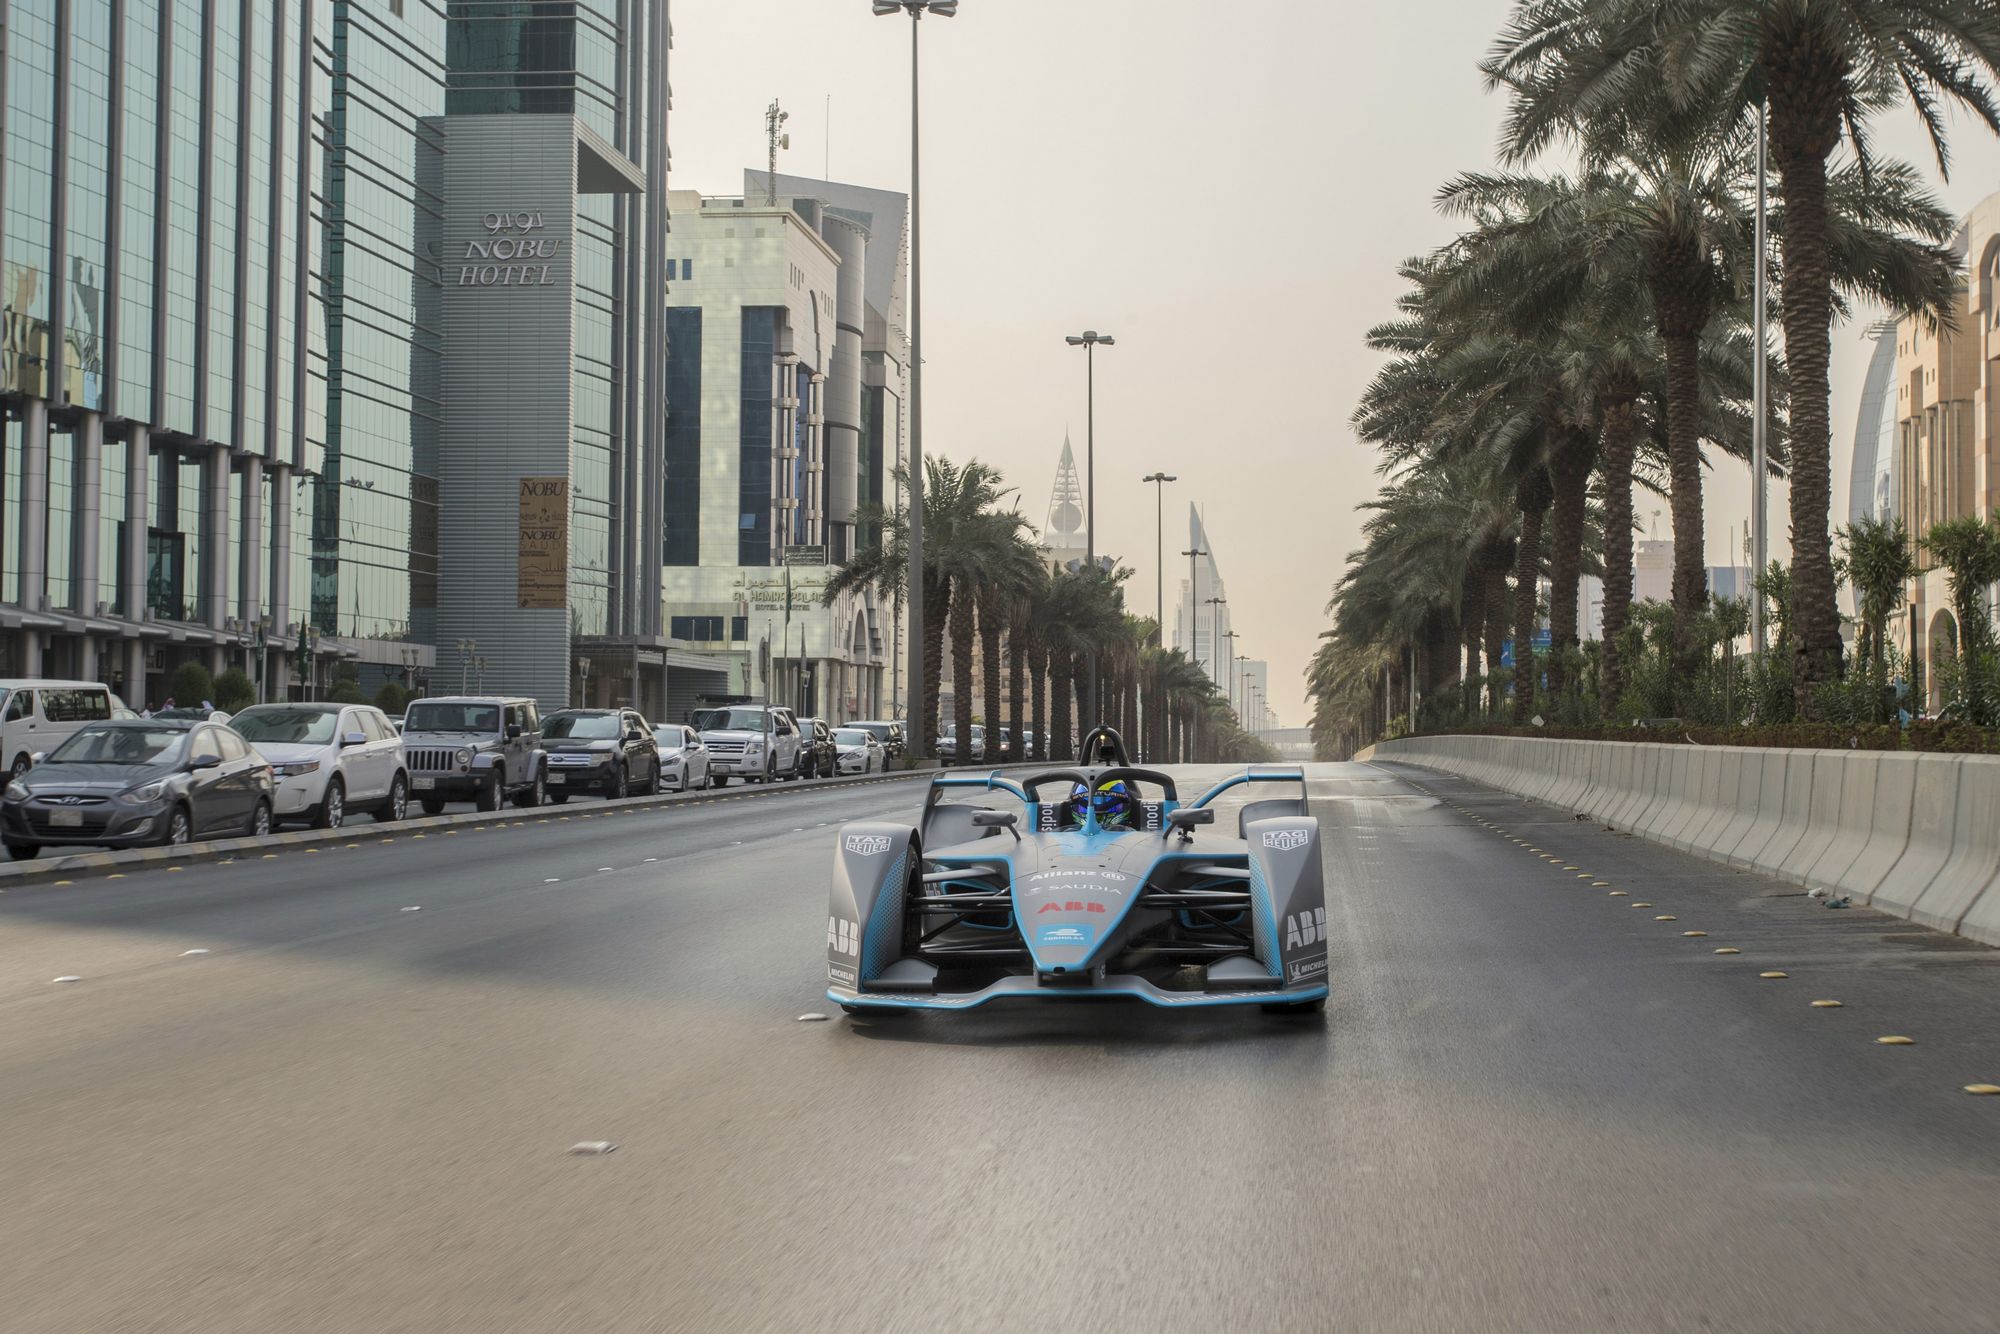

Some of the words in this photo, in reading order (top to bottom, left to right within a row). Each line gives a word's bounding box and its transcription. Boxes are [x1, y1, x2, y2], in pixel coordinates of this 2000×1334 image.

[463, 239, 561, 260] NOBU
[459, 266, 555, 286] HOTEL
[521, 482, 567, 497] NOBU
[520, 530, 564, 541] NOBU
[851, 836, 887, 844] TAG
[1266, 838, 1307, 849] HEUER
[849, 843, 888, 855] HEUER
[1029, 871, 1097, 882] Allianz
[1048, 884, 1122, 896] SAUDIA
[1037, 901, 1105, 915] ABB
[828, 916, 859, 957] ABB
[1301, 958, 1327, 974] MICHELI
[831, 968, 855, 982] MICHELIN
